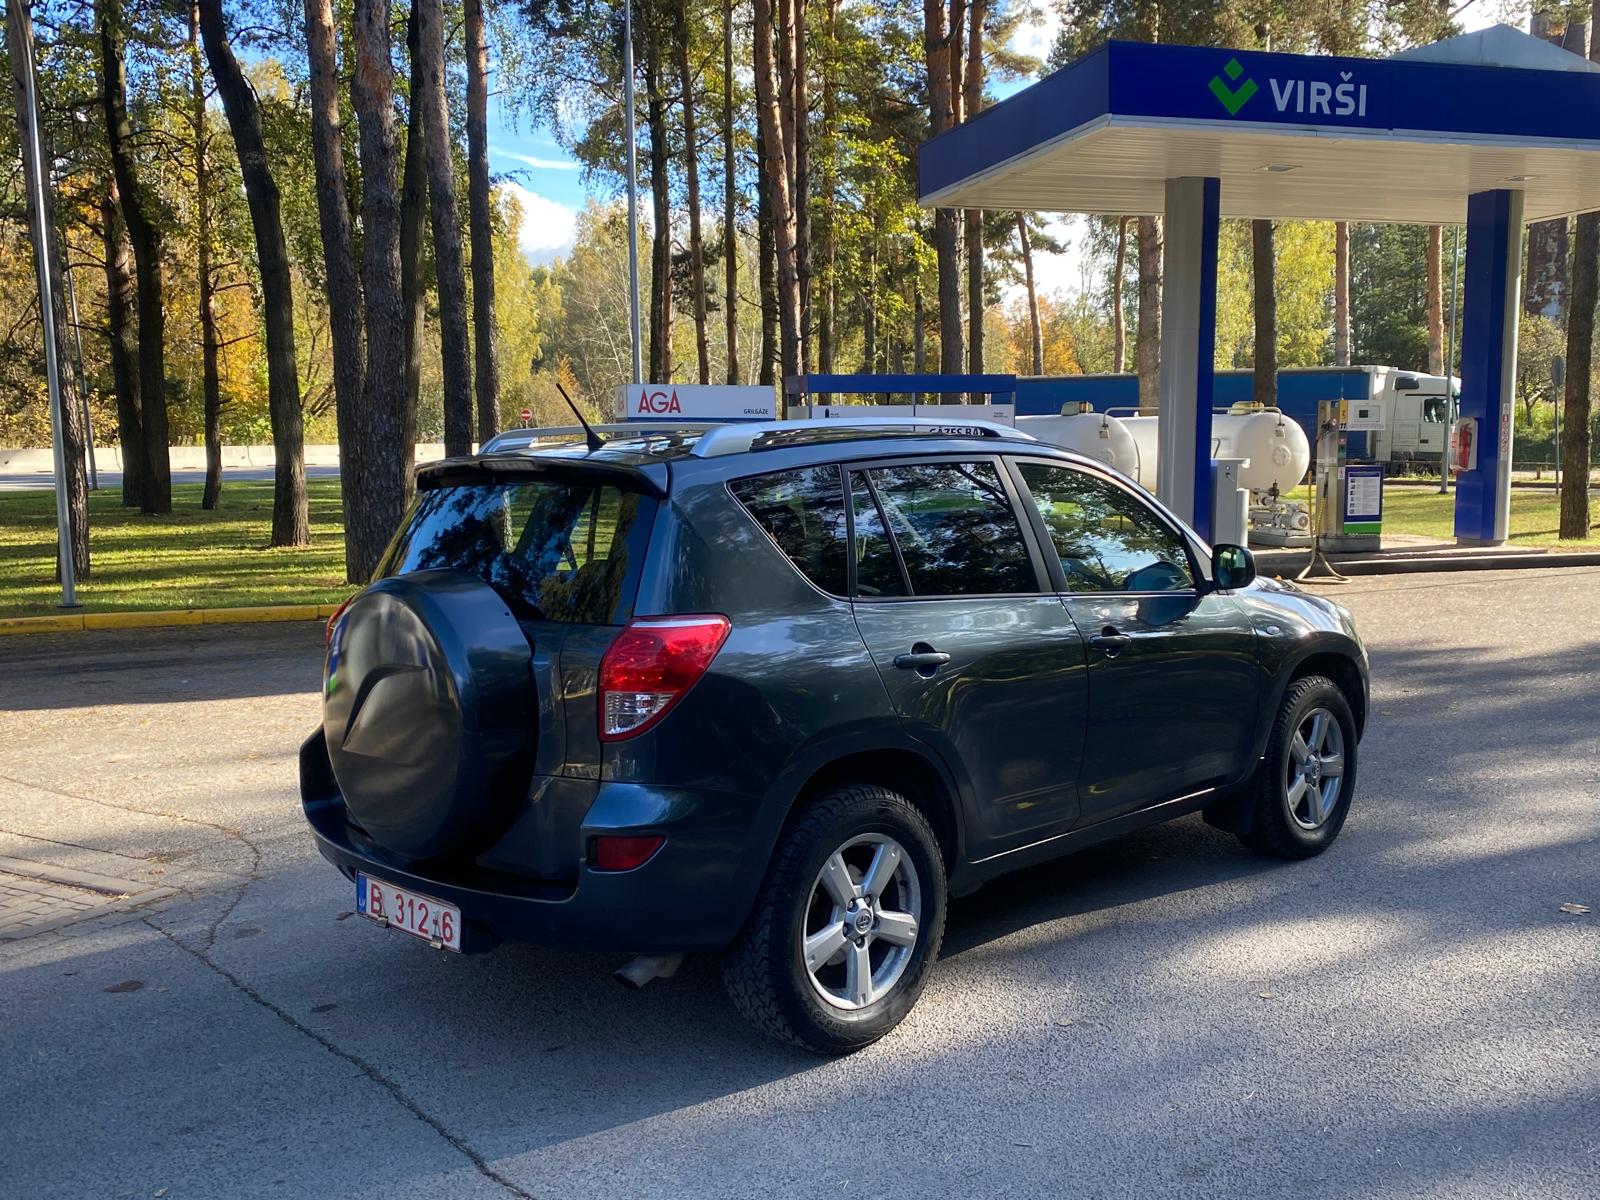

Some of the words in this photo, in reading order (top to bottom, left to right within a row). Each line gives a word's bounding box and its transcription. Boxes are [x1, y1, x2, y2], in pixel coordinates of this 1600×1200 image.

[1269, 71, 1367, 116] VIRŠI
[638, 387, 681, 413] AGA
[358, 897, 366, 907] LV
[370, 883, 382, 915] B
